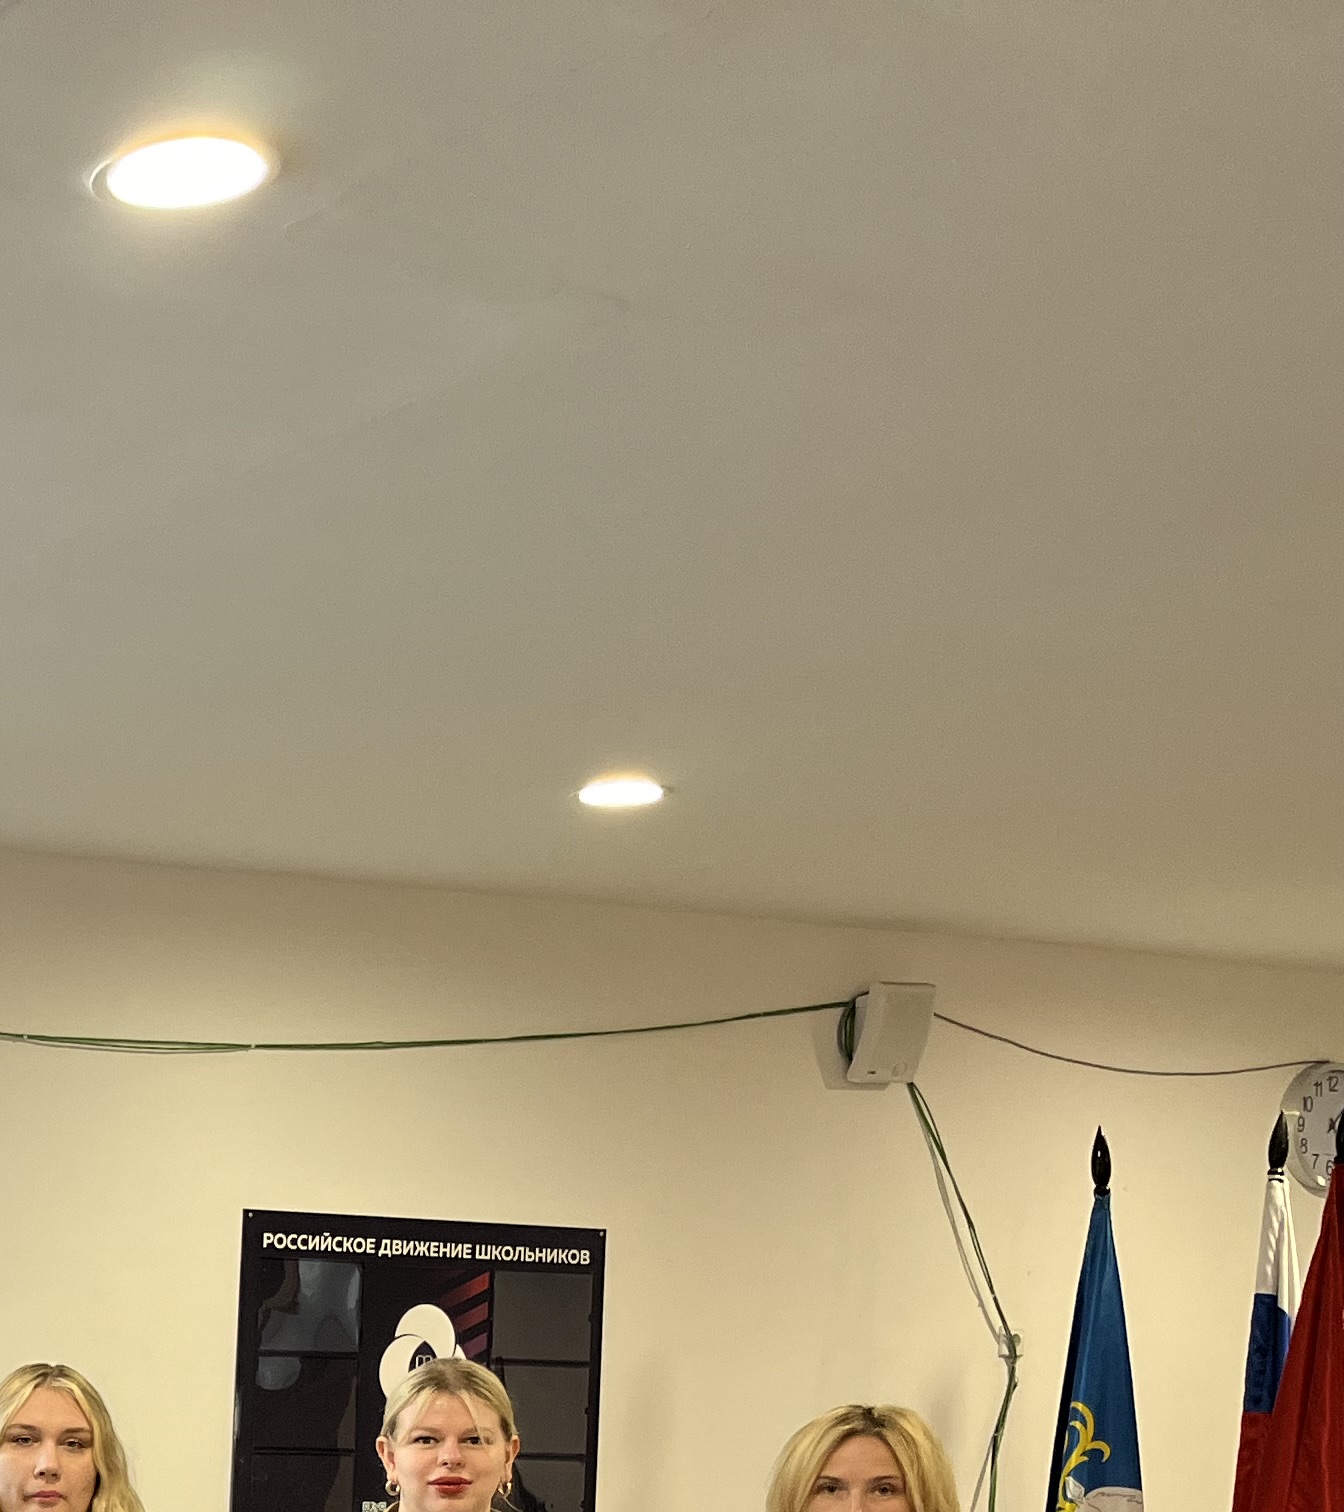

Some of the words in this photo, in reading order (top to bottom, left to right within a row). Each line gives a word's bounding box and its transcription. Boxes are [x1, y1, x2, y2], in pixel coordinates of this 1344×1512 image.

[1314, 1081, 1323, 1097] 11
[1327, 1076, 1339, 1092] 12
[1303, 1096, 1313, 1112] 10
[1297, 1116, 1305, 1132] 9
[1300, 1138, 1308, 1154] 8
[1312, 1154, 1320, 1169] 7
[262, 1232, 376, 1254] РОССИЙСКОЕ
[378, 1238, 472, 1259] ДВИЖЕНИЕ
[475, 1244, 590, 1265] ШКОЛЬНИКОВ
